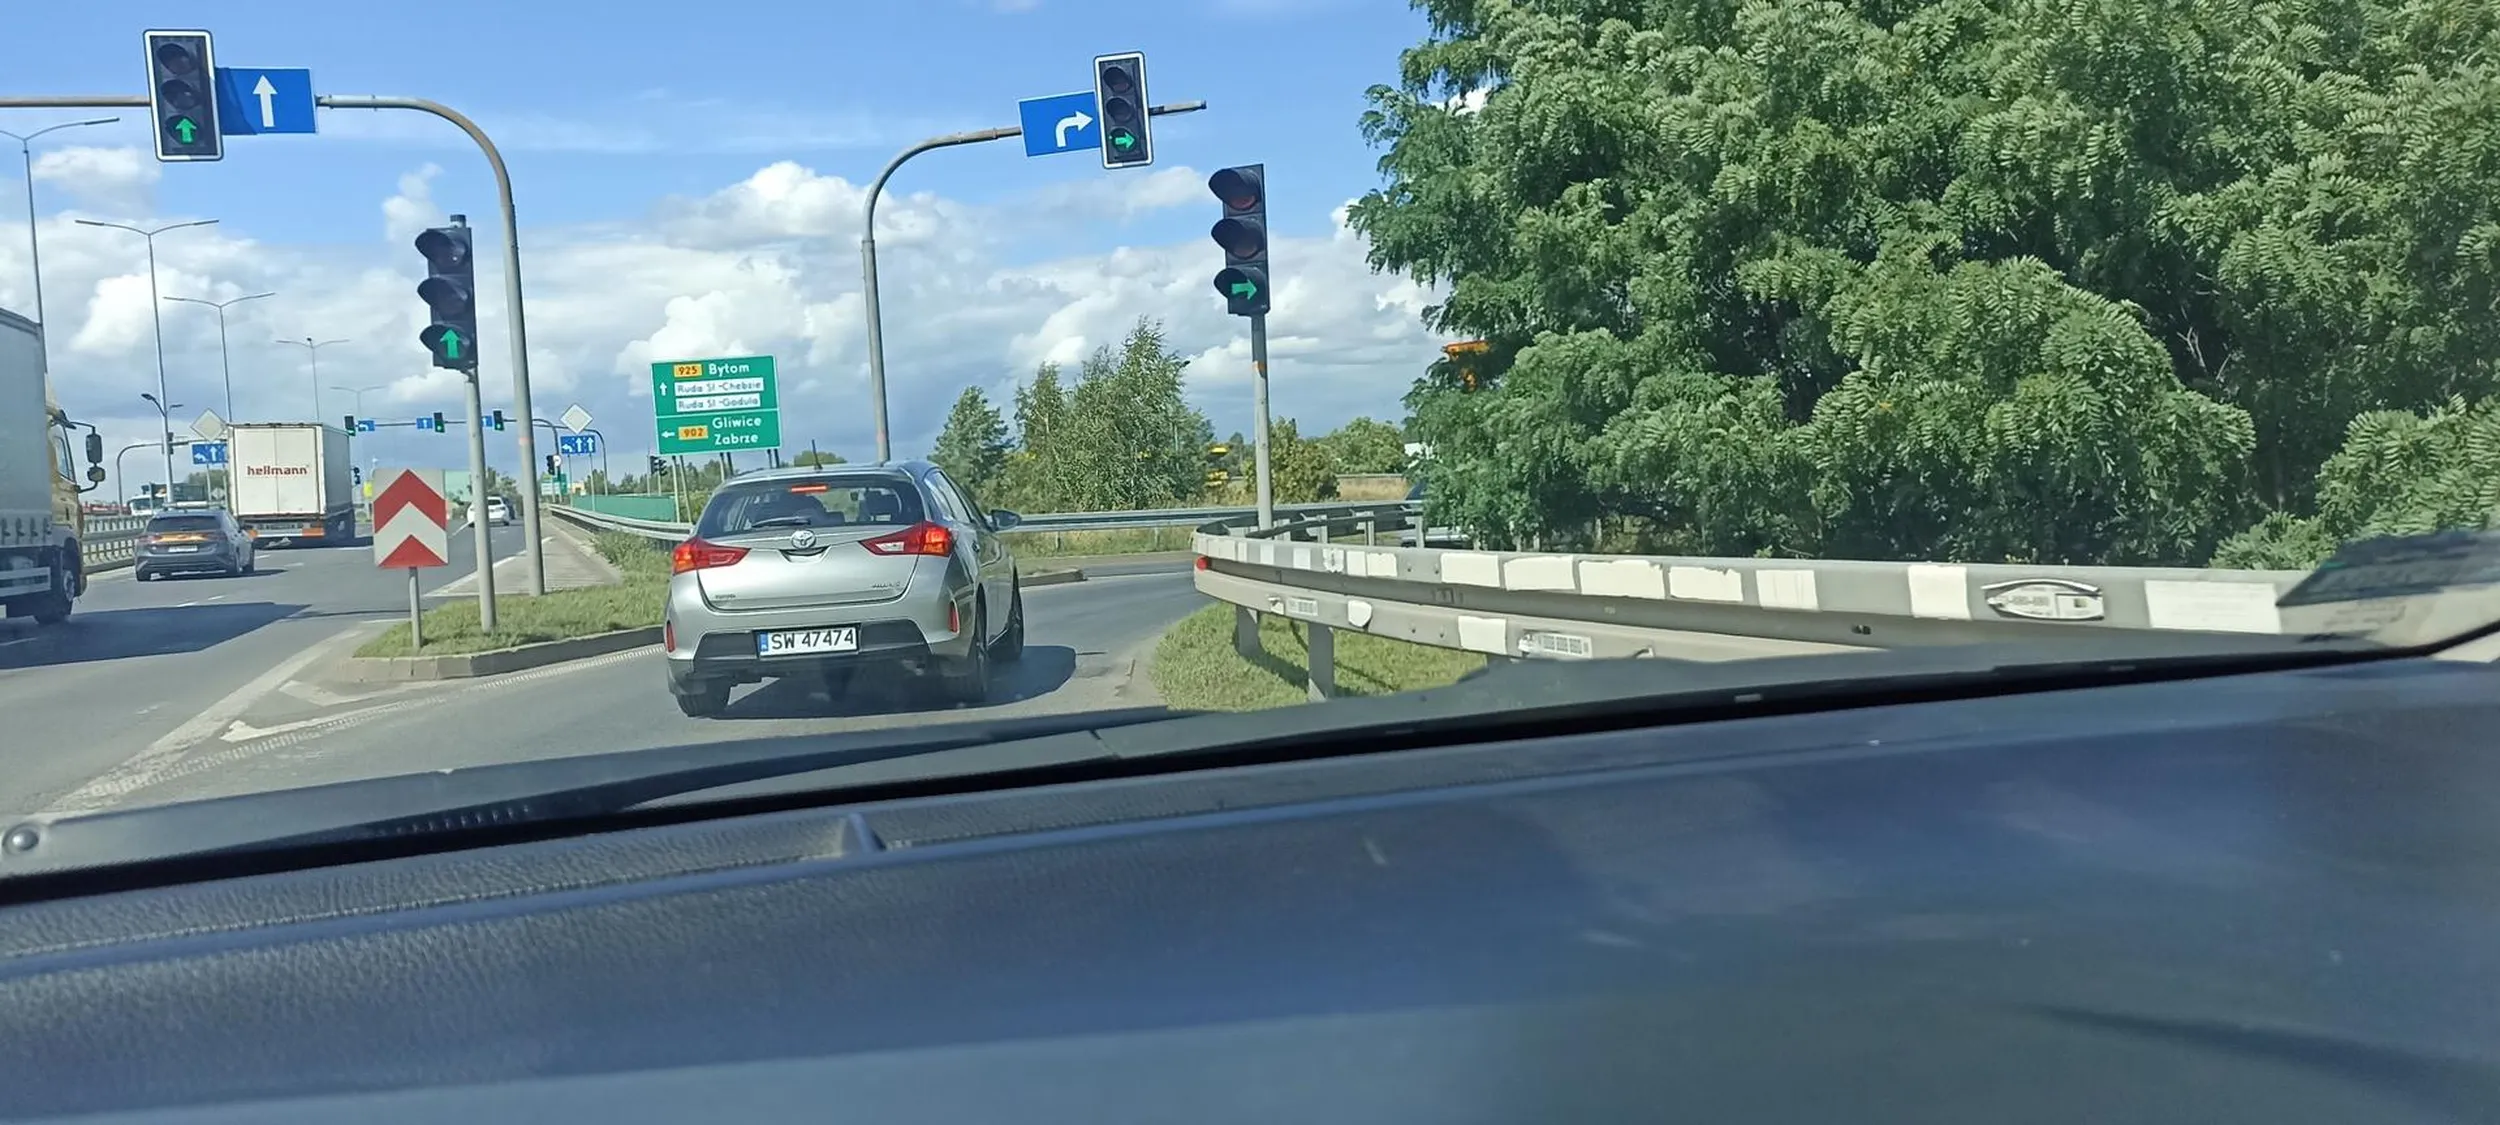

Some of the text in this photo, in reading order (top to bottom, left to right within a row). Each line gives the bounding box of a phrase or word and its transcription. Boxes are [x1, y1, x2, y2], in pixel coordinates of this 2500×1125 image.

[678, 363, 750, 376] 925 Bytom
[677, 383, 703, 393] Ruda
[678, 398, 704, 409] Ruda
[712, 417, 762, 429] Gliwice
[683, 427, 759, 445] 902 Zabrze
[247, 465, 308, 475] hellmann
[771, 629, 854, 650] SW 47474
